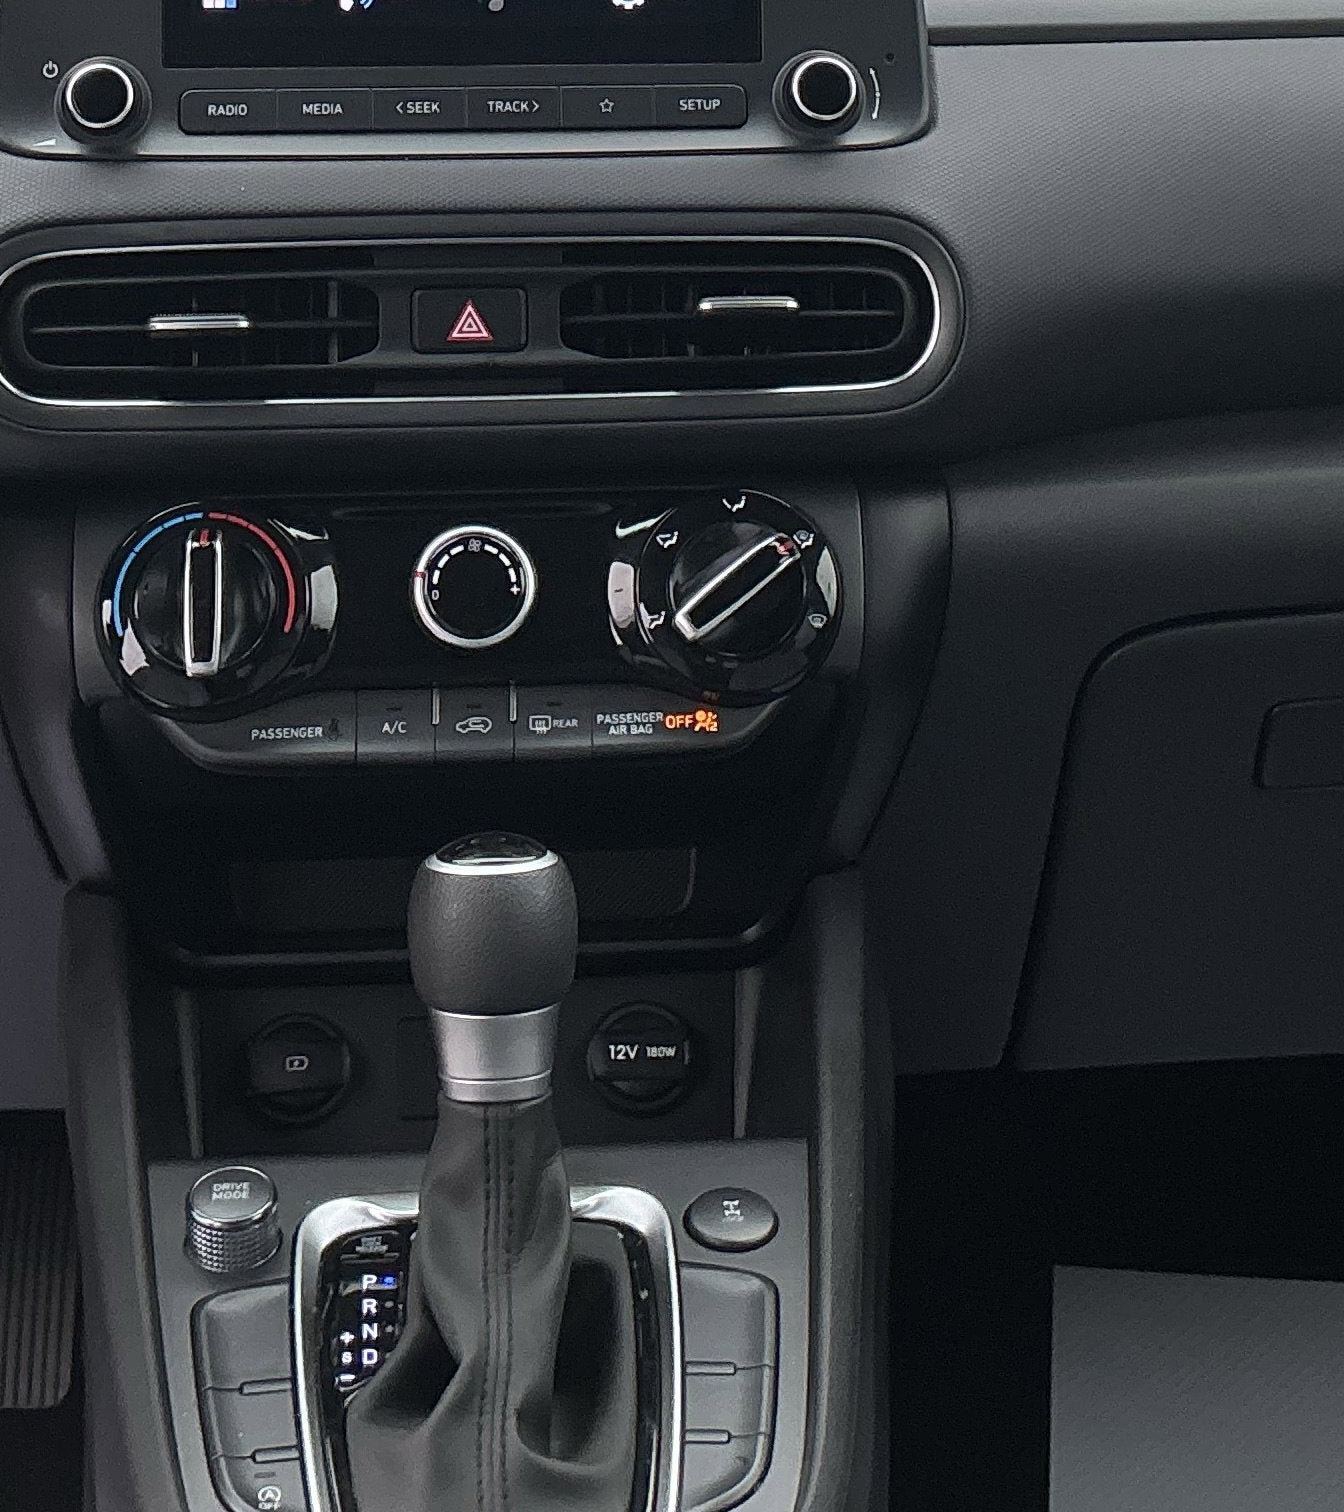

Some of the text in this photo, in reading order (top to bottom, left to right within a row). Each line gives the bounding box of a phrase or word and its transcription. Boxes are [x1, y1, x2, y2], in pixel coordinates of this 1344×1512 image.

[207, 104, 248, 116] RADIO
[302, 103, 343, 115] MEDIA
[679, 99, 721, 111] SETUP
[553, 719, 579, 728] REAR
[596, 712, 663, 725] PASSENGER
[665, 715, 695, 729] OFF
[251, 726, 323, 740] PASSENGER
[381, 720, 407, 734] A/C
[608, 724, 653, 735] AIR BAG
[608, 1044, 676, 1060] 12V 180W
[213, 1182, 250, 1192] DRIVE
[212, 1190, 249, 1200] MODE
[362, 1274, 377, 1291] P
[362, 1298, 377, 1315] R
[362, 1323, 378, 1340] N
[362, 1348, 378, 1365] D
